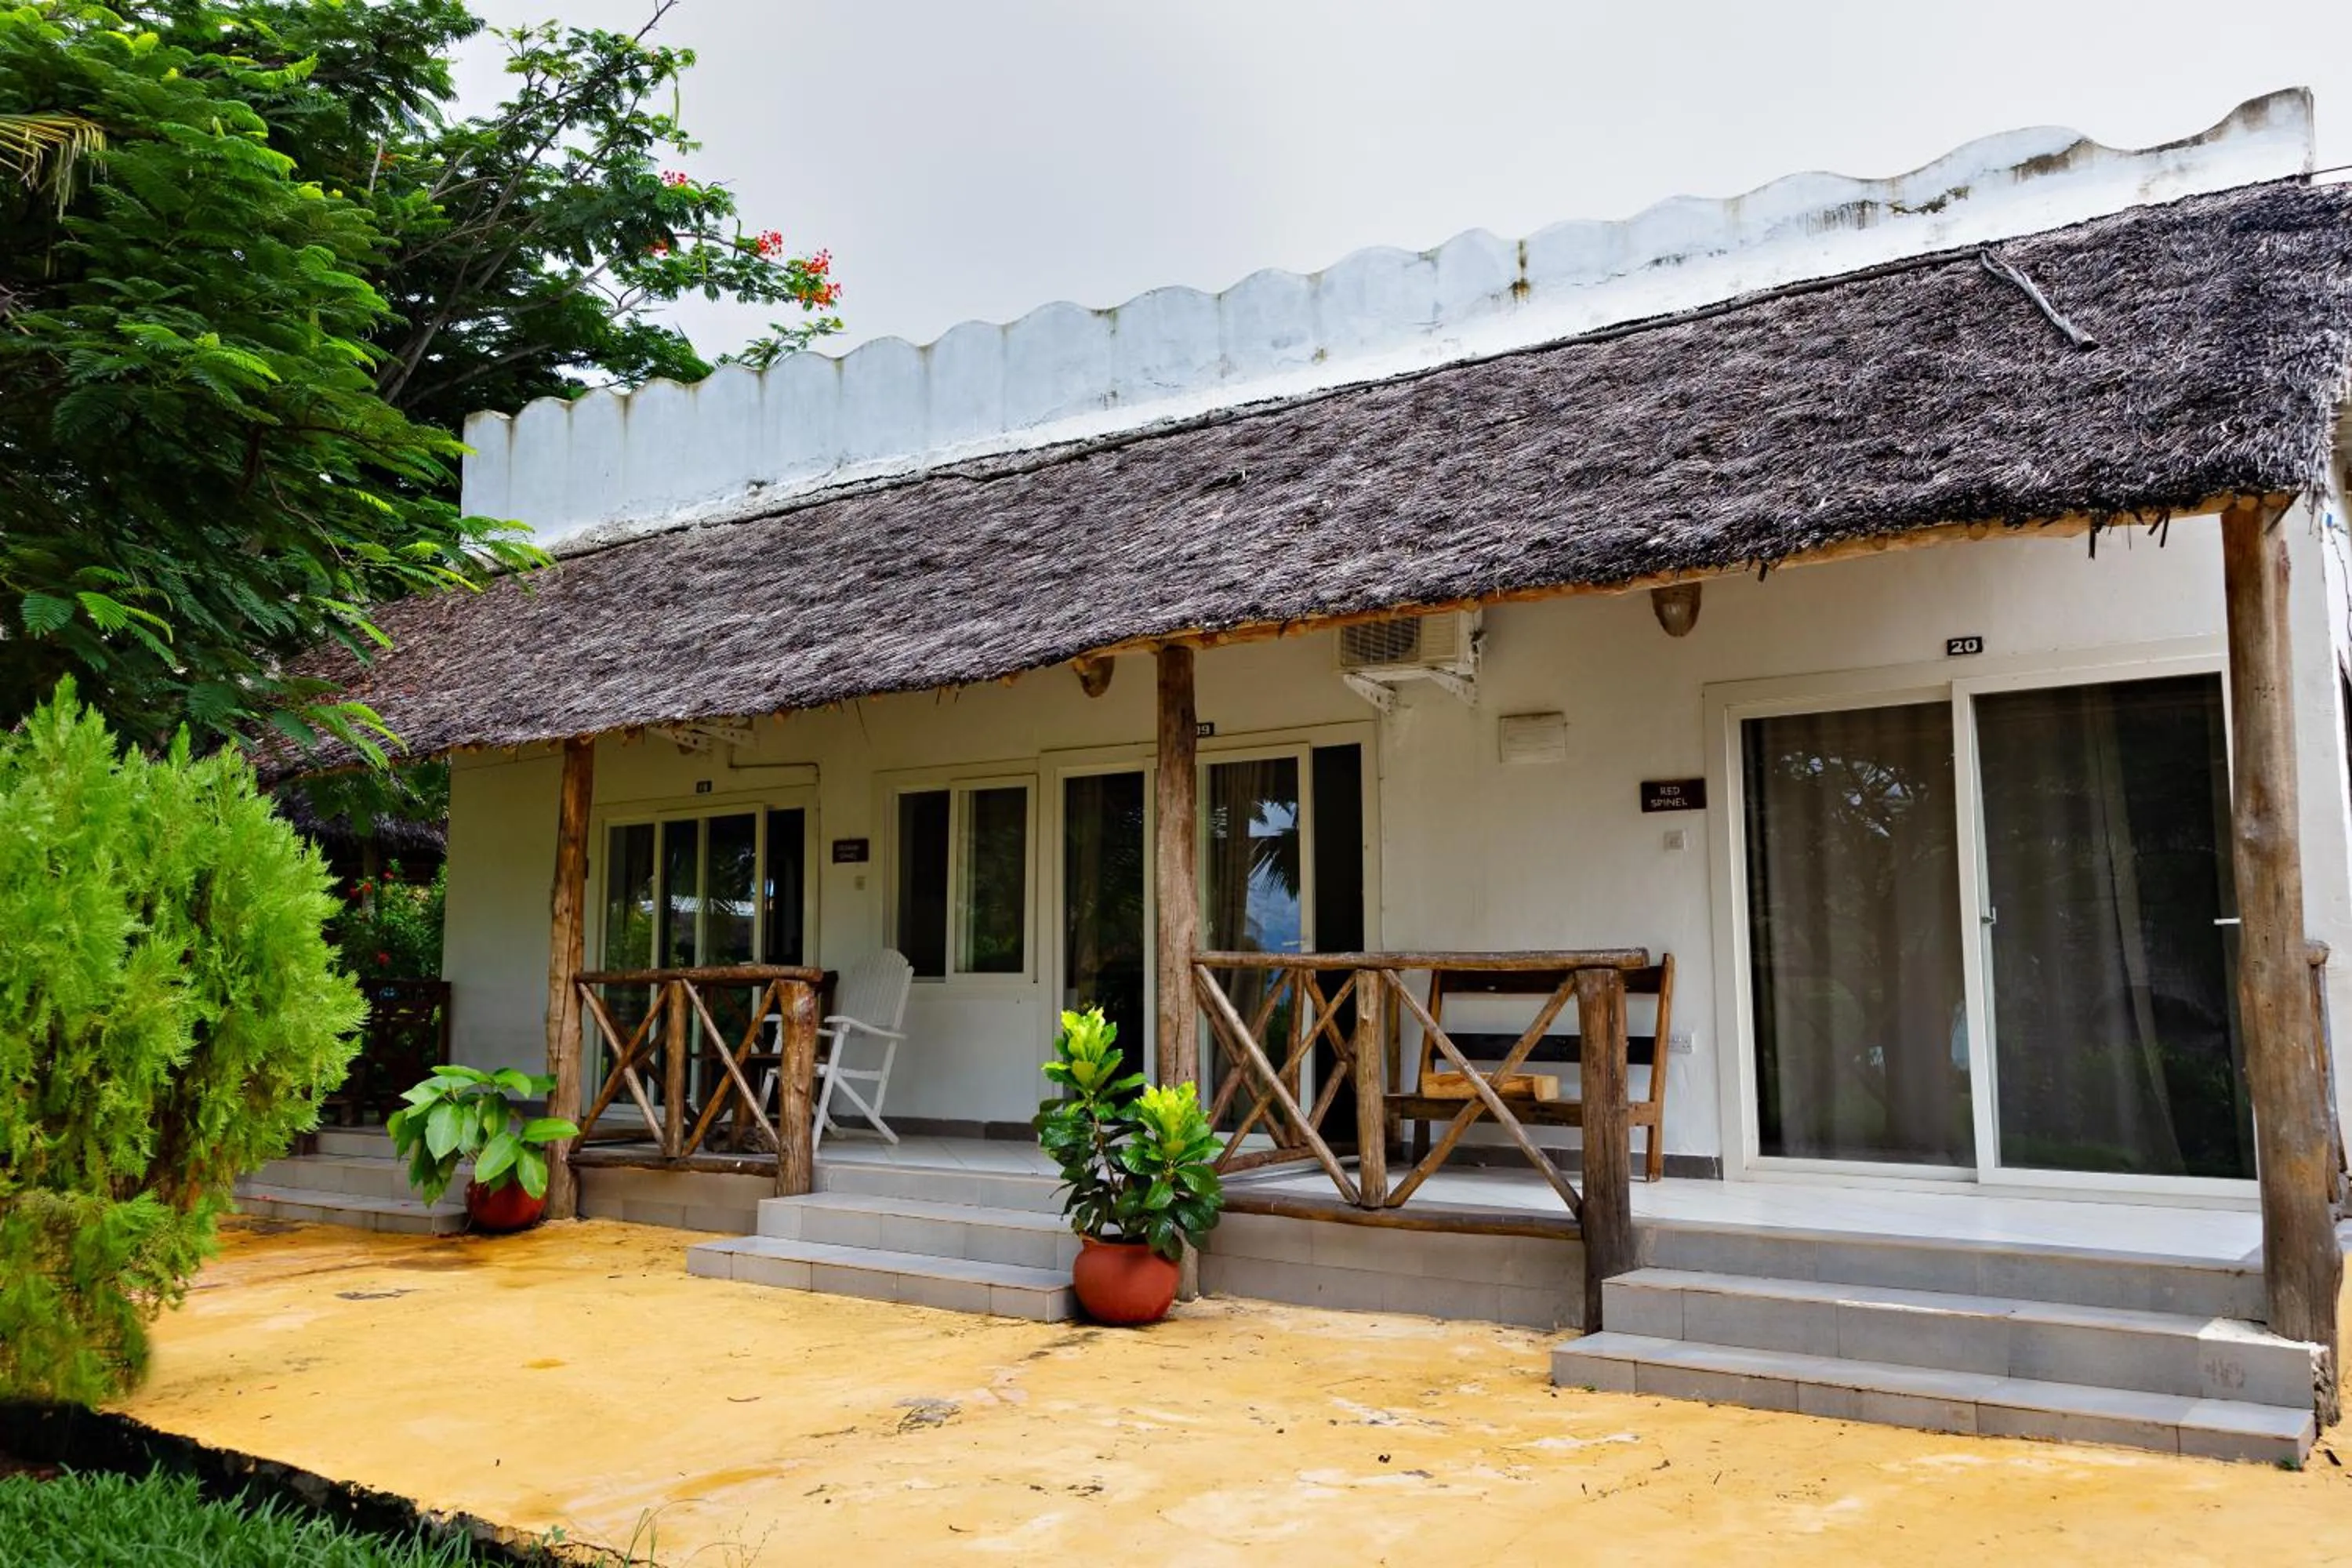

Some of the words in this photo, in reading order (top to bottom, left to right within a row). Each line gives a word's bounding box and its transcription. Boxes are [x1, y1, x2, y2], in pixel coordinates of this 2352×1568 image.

[1951, 639, 1977, 653] 20
[1659, 786, 1680, 796] RED
[1650, 797, 1688, 808] SPINEL
